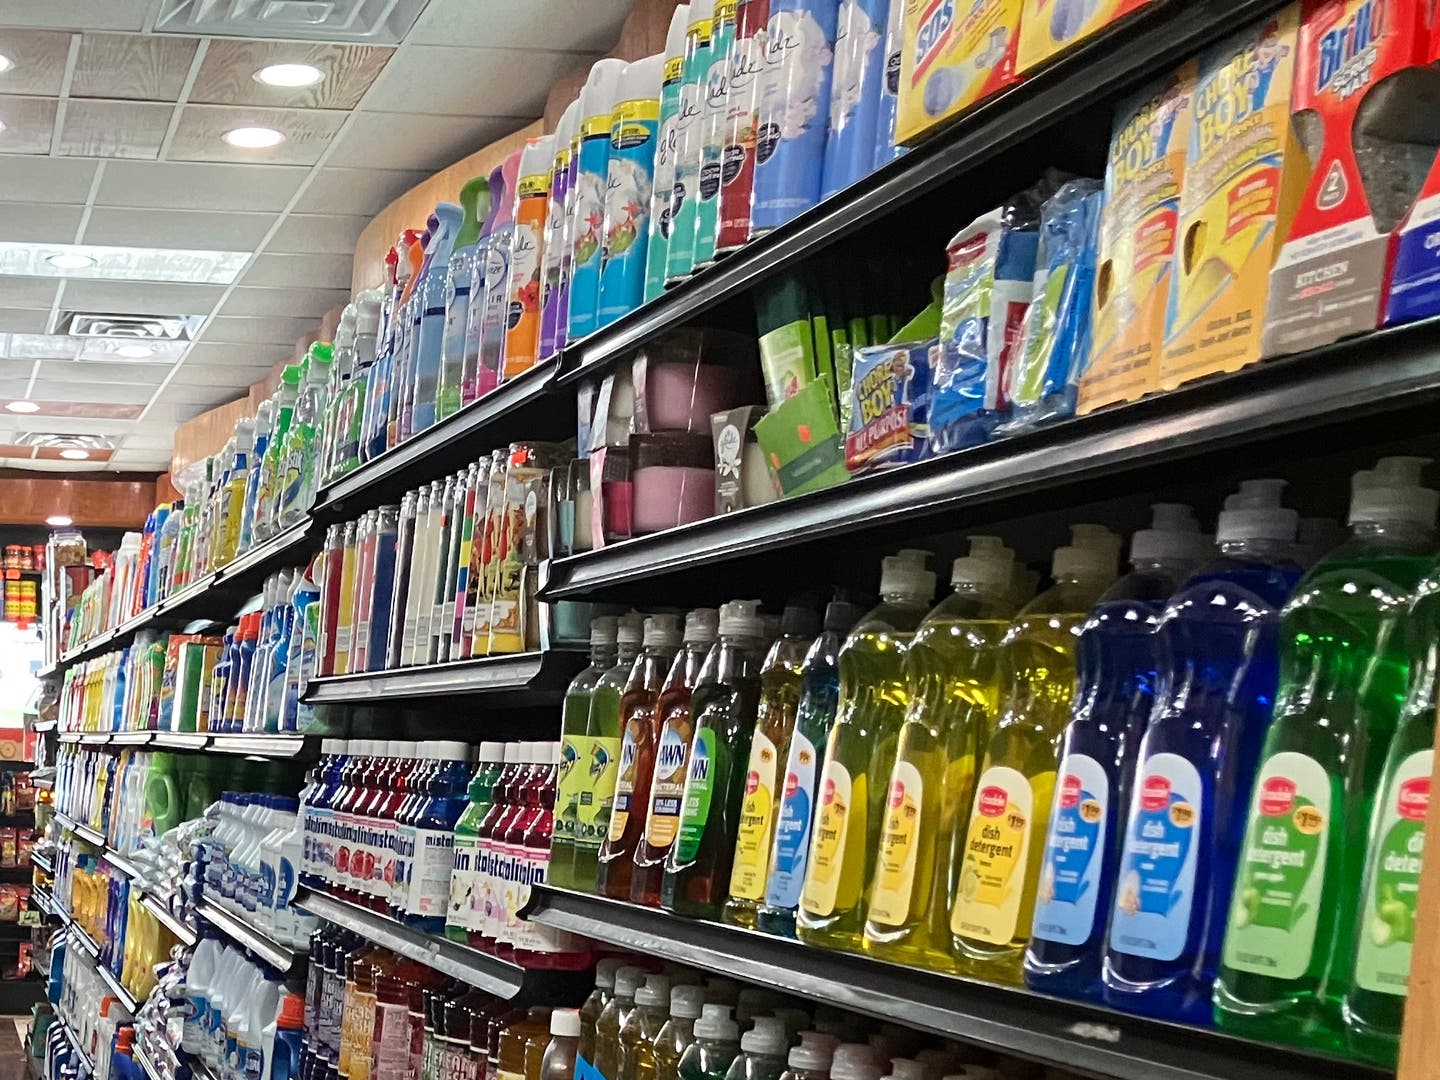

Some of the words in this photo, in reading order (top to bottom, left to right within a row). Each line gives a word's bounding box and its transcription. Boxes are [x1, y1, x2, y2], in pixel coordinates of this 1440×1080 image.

[861, 382, 894, 424] BOY
[659, 744, 686, 766] AWN
[982, 825, 1001, 841] dish
[1262, 825, 1288, 847] dish
[970, 838, 1013, 858] detergent
[1384, 852, 1423, 874] dete
